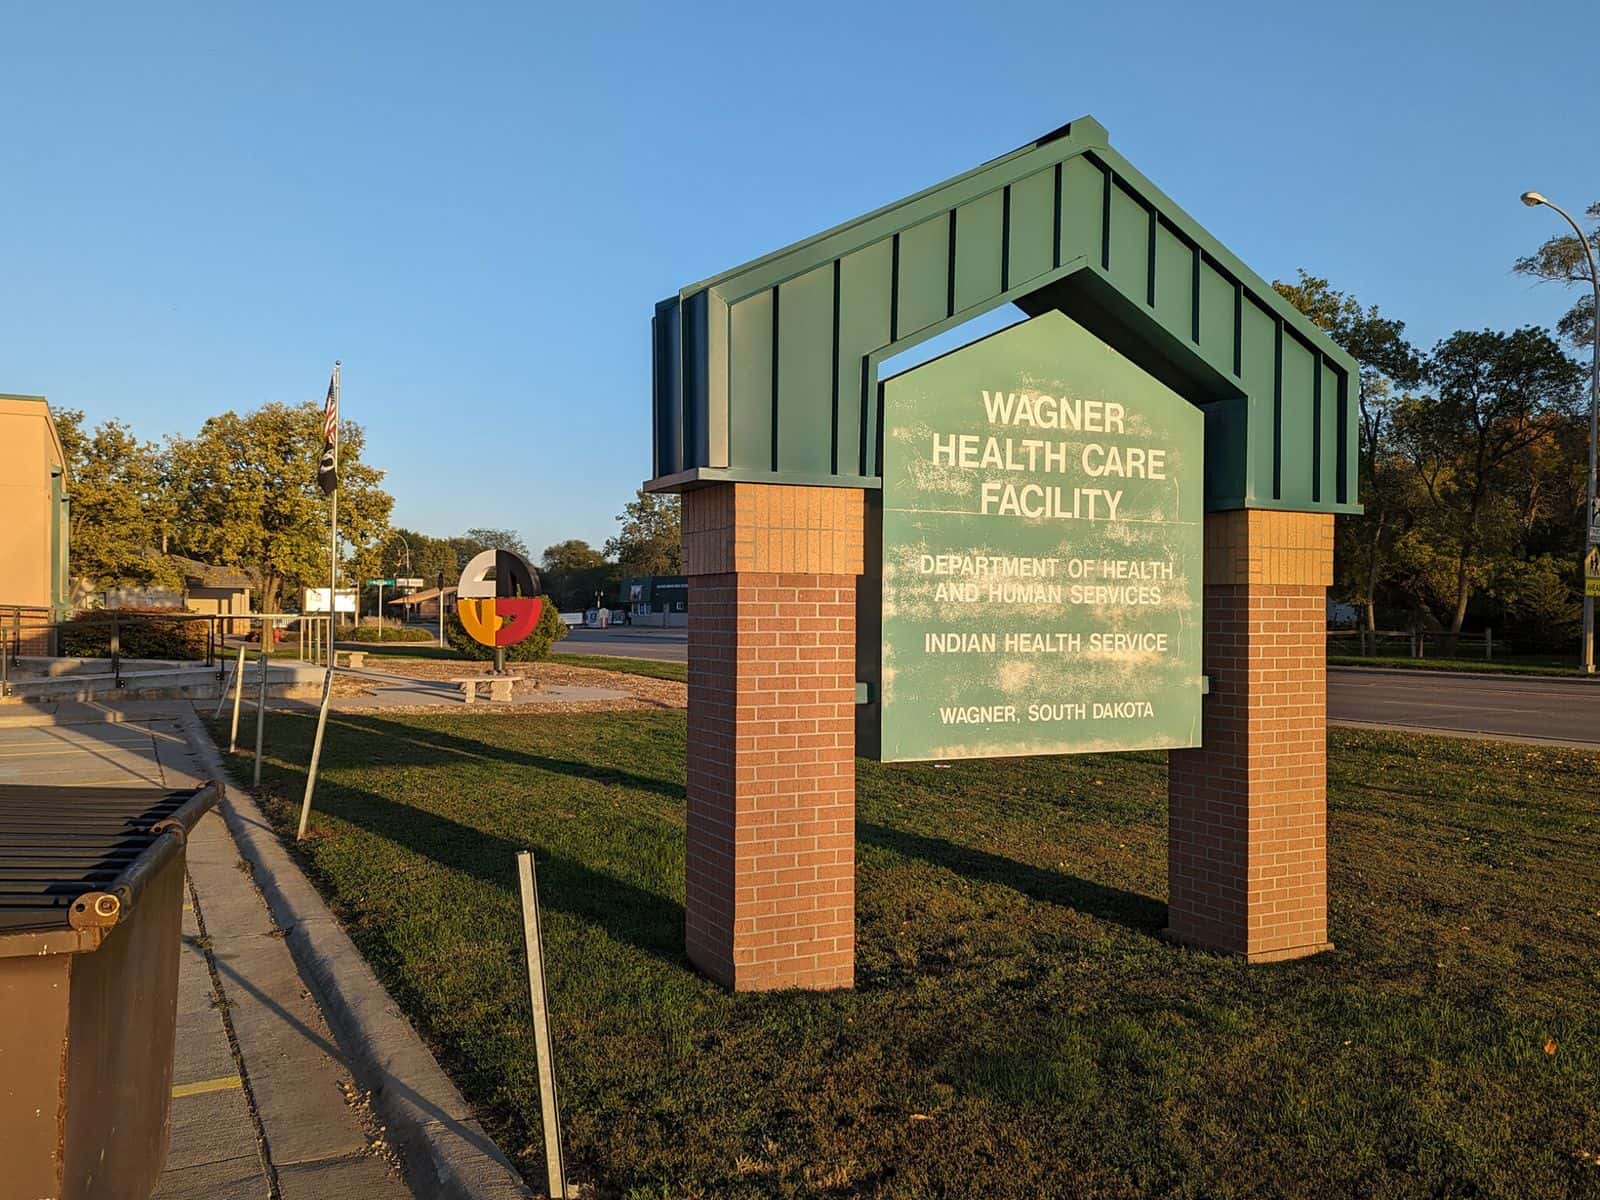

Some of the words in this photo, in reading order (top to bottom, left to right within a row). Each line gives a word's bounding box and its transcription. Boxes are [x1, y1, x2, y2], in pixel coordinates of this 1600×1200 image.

[981, 390, 1125, 434] WAGNER
[931, 432, 1067, 473] HEALTH
[1081, 443, 1167, 480] CARE
[980, 483, 1123, 521] FACILITY
[920, 554, 1060, 578] DEPARTMENT
[1067, 559, 1100, 579] OF
[1102, 560, 1174, 580] HEALTH
[934, 582, 980, 602] AND
[989, 584, 1062, 604] HUMAN
[1070, 585, 1162, 606] SERVICES
[925, 633, 996, 653] INDIAN
[1004, 633, 1081, 652] HEALTH
[1089, 633, 1169, 652] SERVICE
[939, 706, 1021, 724] WAGNER,
[1027, 703, 1087, 722] SOUTH
[1092, 702, 1154, 720] DAKOTA
